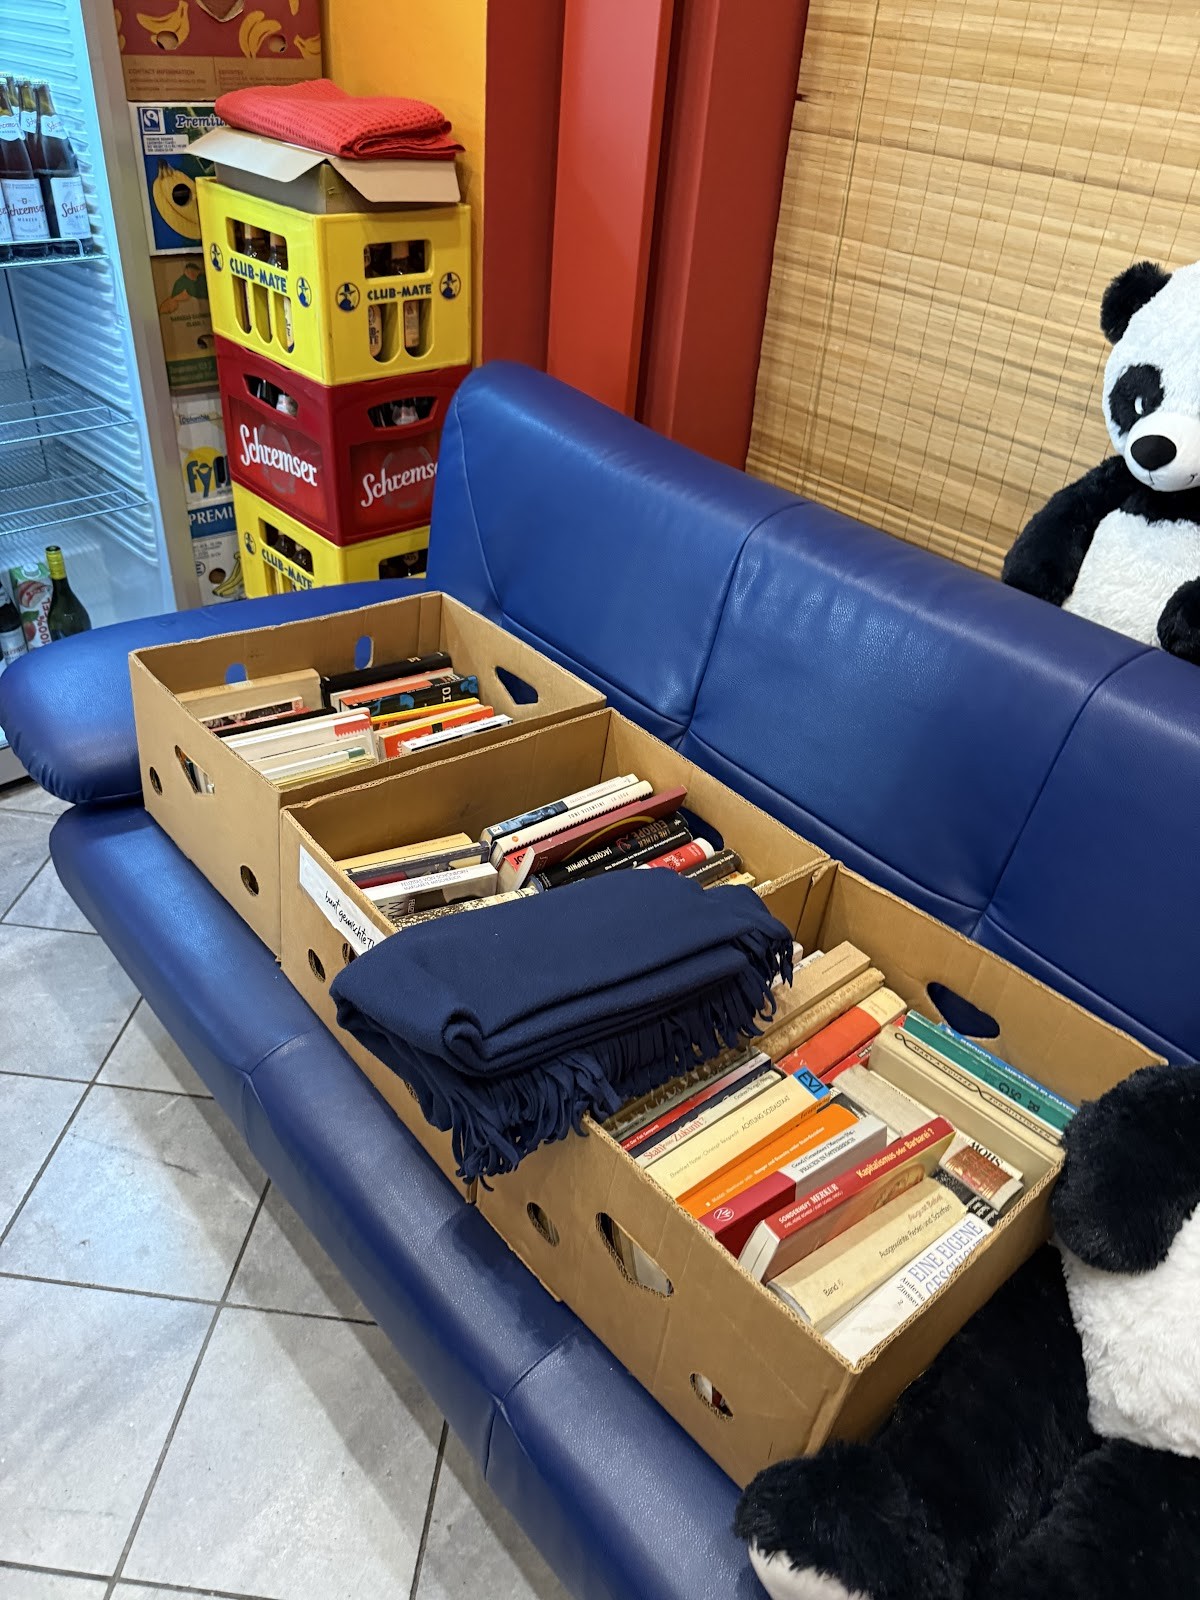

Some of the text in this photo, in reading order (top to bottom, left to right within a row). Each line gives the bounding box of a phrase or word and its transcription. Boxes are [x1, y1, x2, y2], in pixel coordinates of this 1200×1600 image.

[229, 257, 288, 293] CLUB-MATE
[367, 283, 432, 301] CLUB-MATE
[239, 423, 318, 487] Schremser
[262, 548, 314, 591] CLUB-MATE
[633, 820, 668, 840] EUROPE
[565, 847, 613, 874] JACQUES RUPNIK
[739, 1111, 764, 1131] ACHTUNG
[761, 1094, 791, 1116] SOZIALSTAAT
[855, 1149, 897, 1179] Kapitalismus
[778, 1182, 839, 1223] SONDERHEFT MERKUR
[907, 1219, 984, 1283] EINE EIGENE
[823, 1284, 838, 1297] Band
[897, 1284, 920, 1307] Zinsser
[900, 1277, 926, 1302] Anderso
